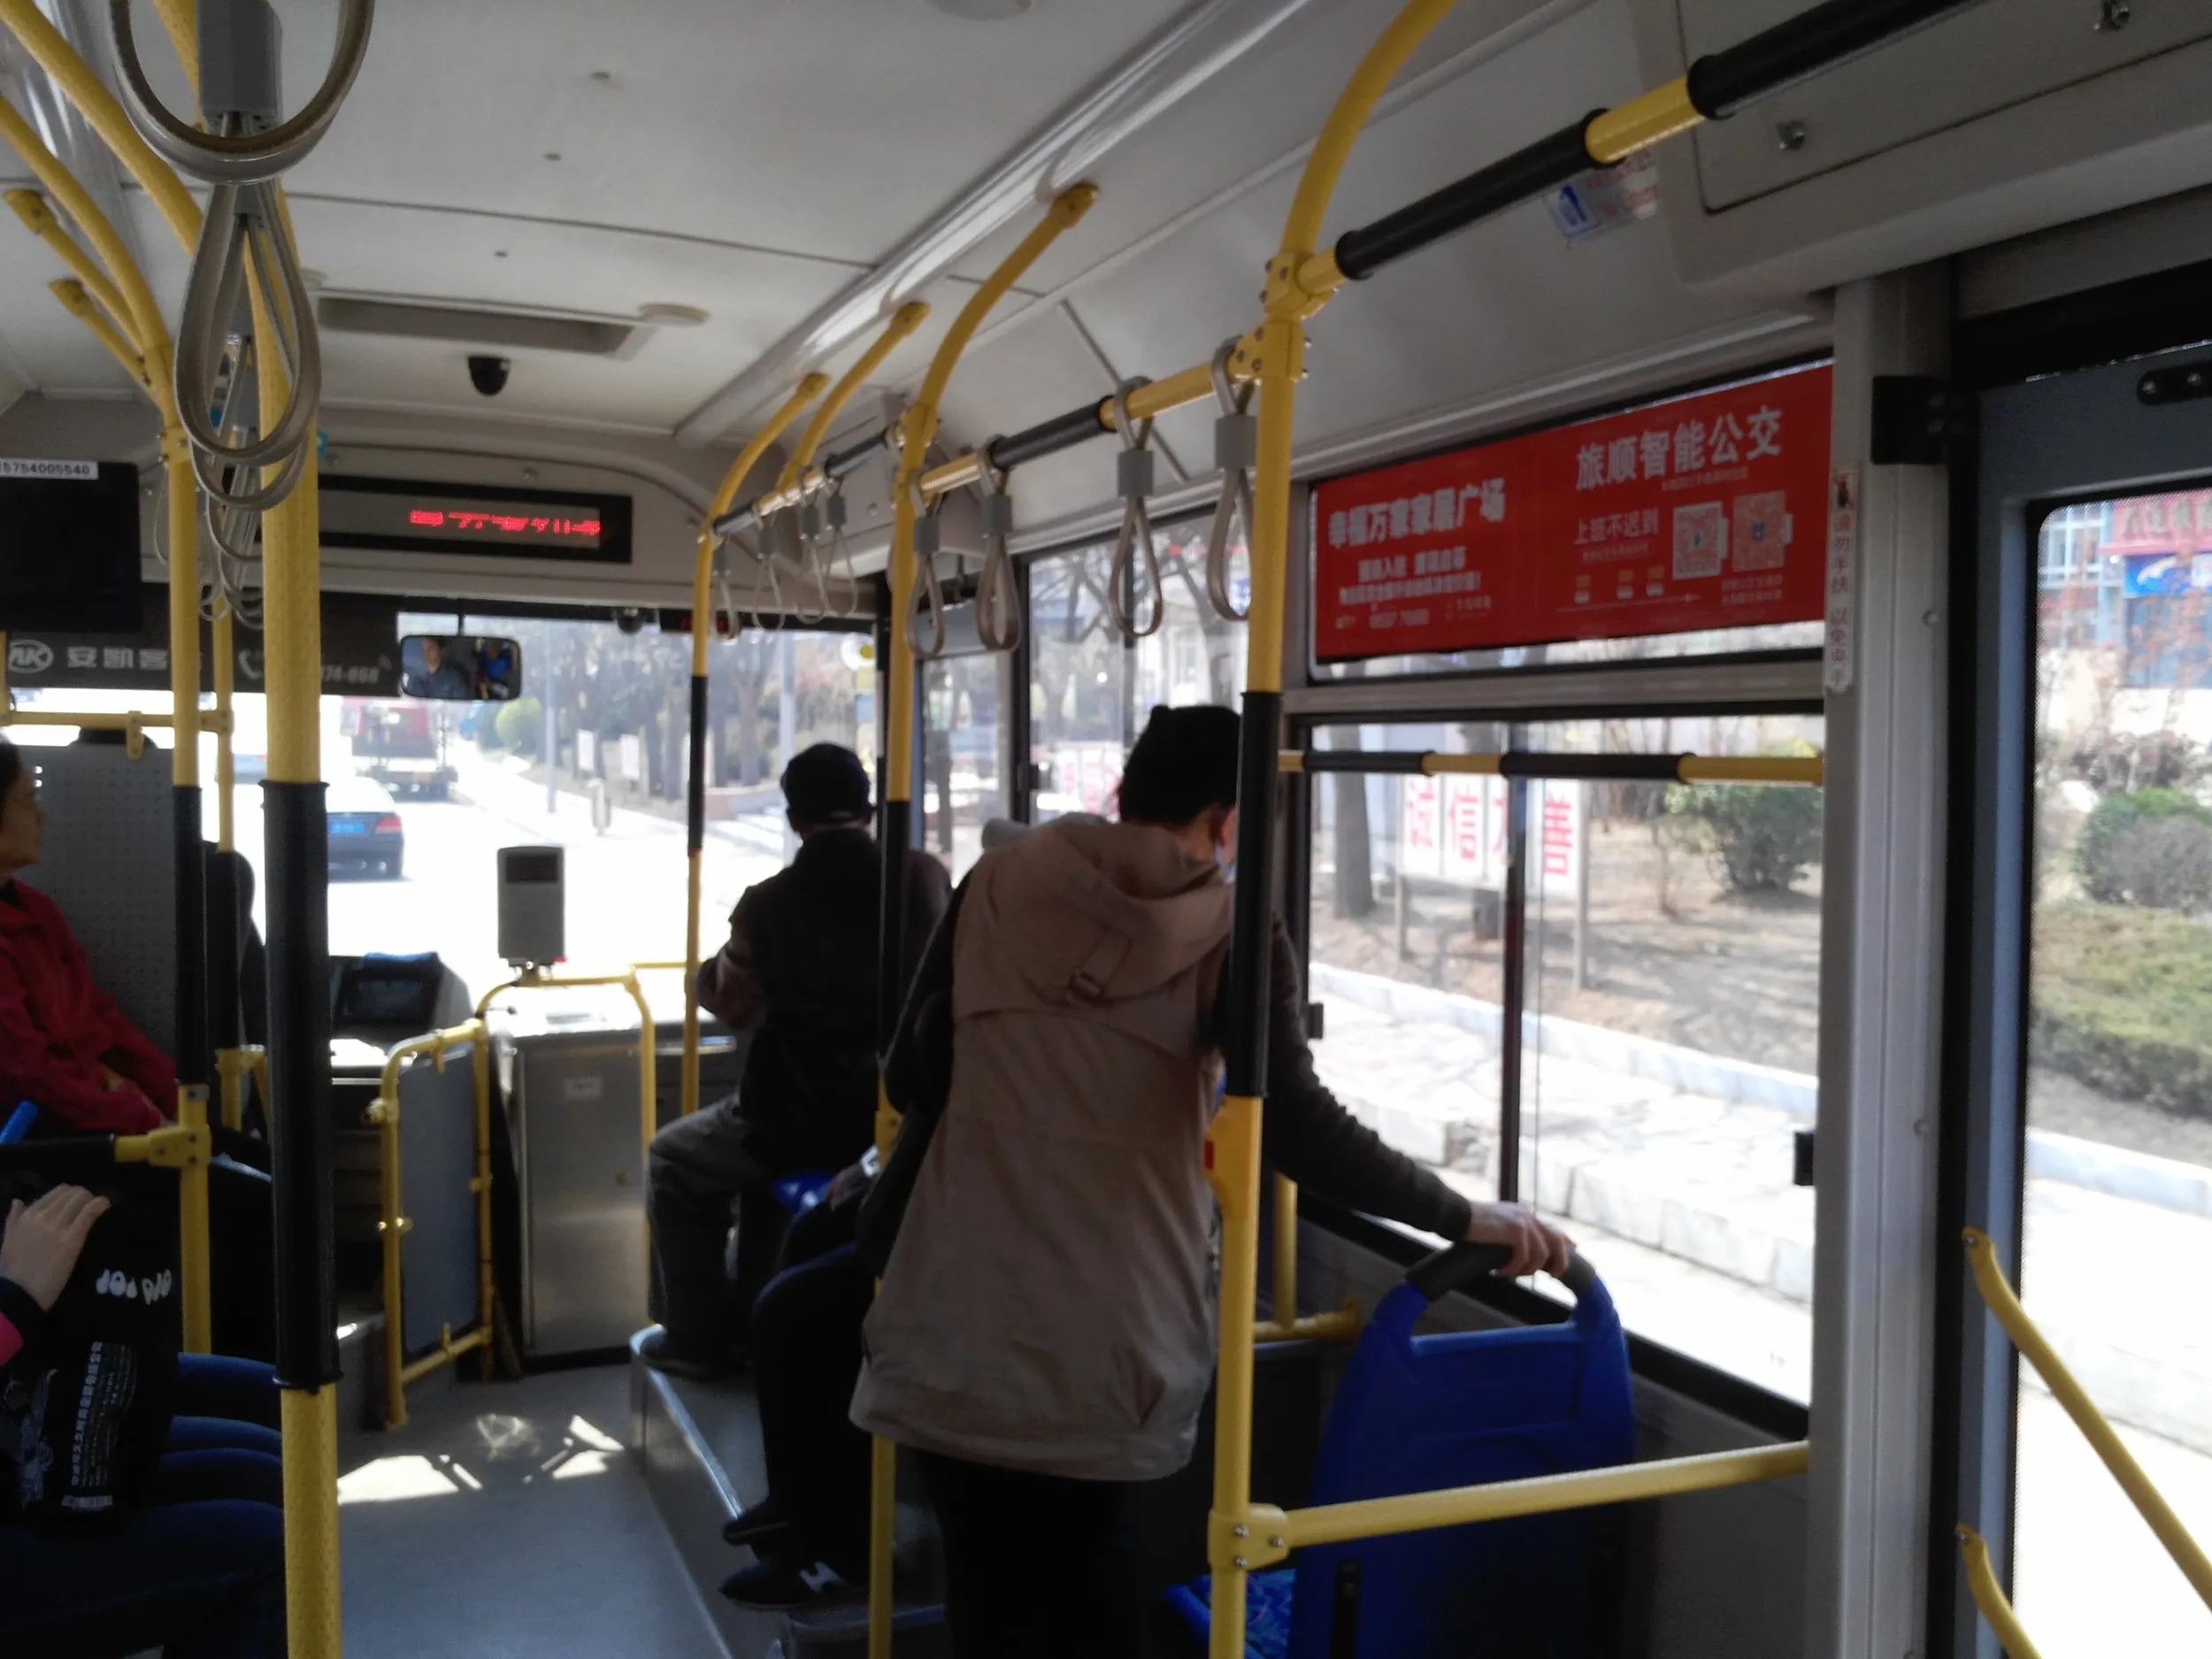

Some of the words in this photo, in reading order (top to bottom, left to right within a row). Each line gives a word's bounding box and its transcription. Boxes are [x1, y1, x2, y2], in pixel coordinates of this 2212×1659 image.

[1575, 404, 1783, 491] 旅顺智能公交
[1573, 506, 1659, 545] 上班不迟到
[66, 645, 170, 671] 安凯客
